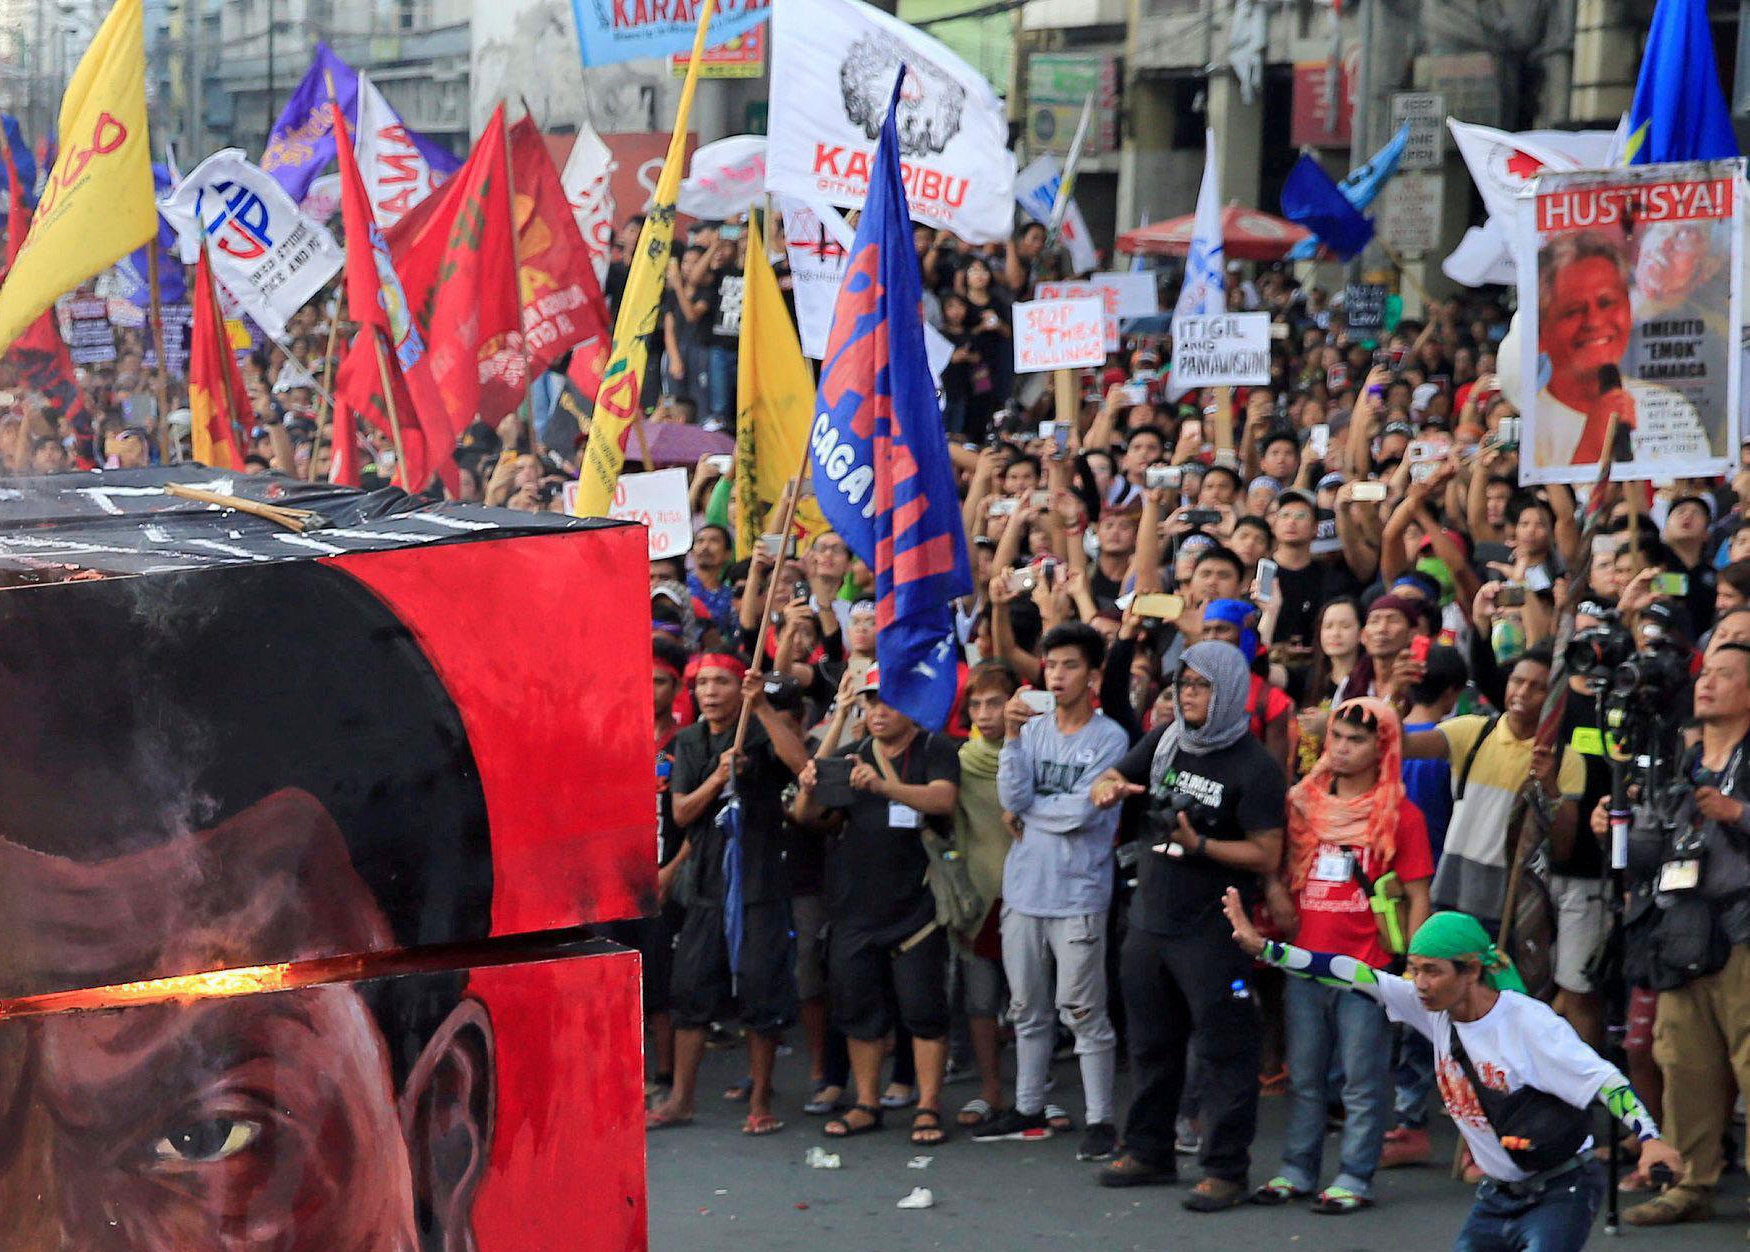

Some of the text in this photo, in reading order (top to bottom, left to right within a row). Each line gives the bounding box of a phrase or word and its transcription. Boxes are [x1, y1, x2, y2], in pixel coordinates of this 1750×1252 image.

[814, 142, 969, 208] KARIBU
[1545, 181, 1724, 228] HUSTISYA!
[1179, 316, 1244, 339] ITIGIL
